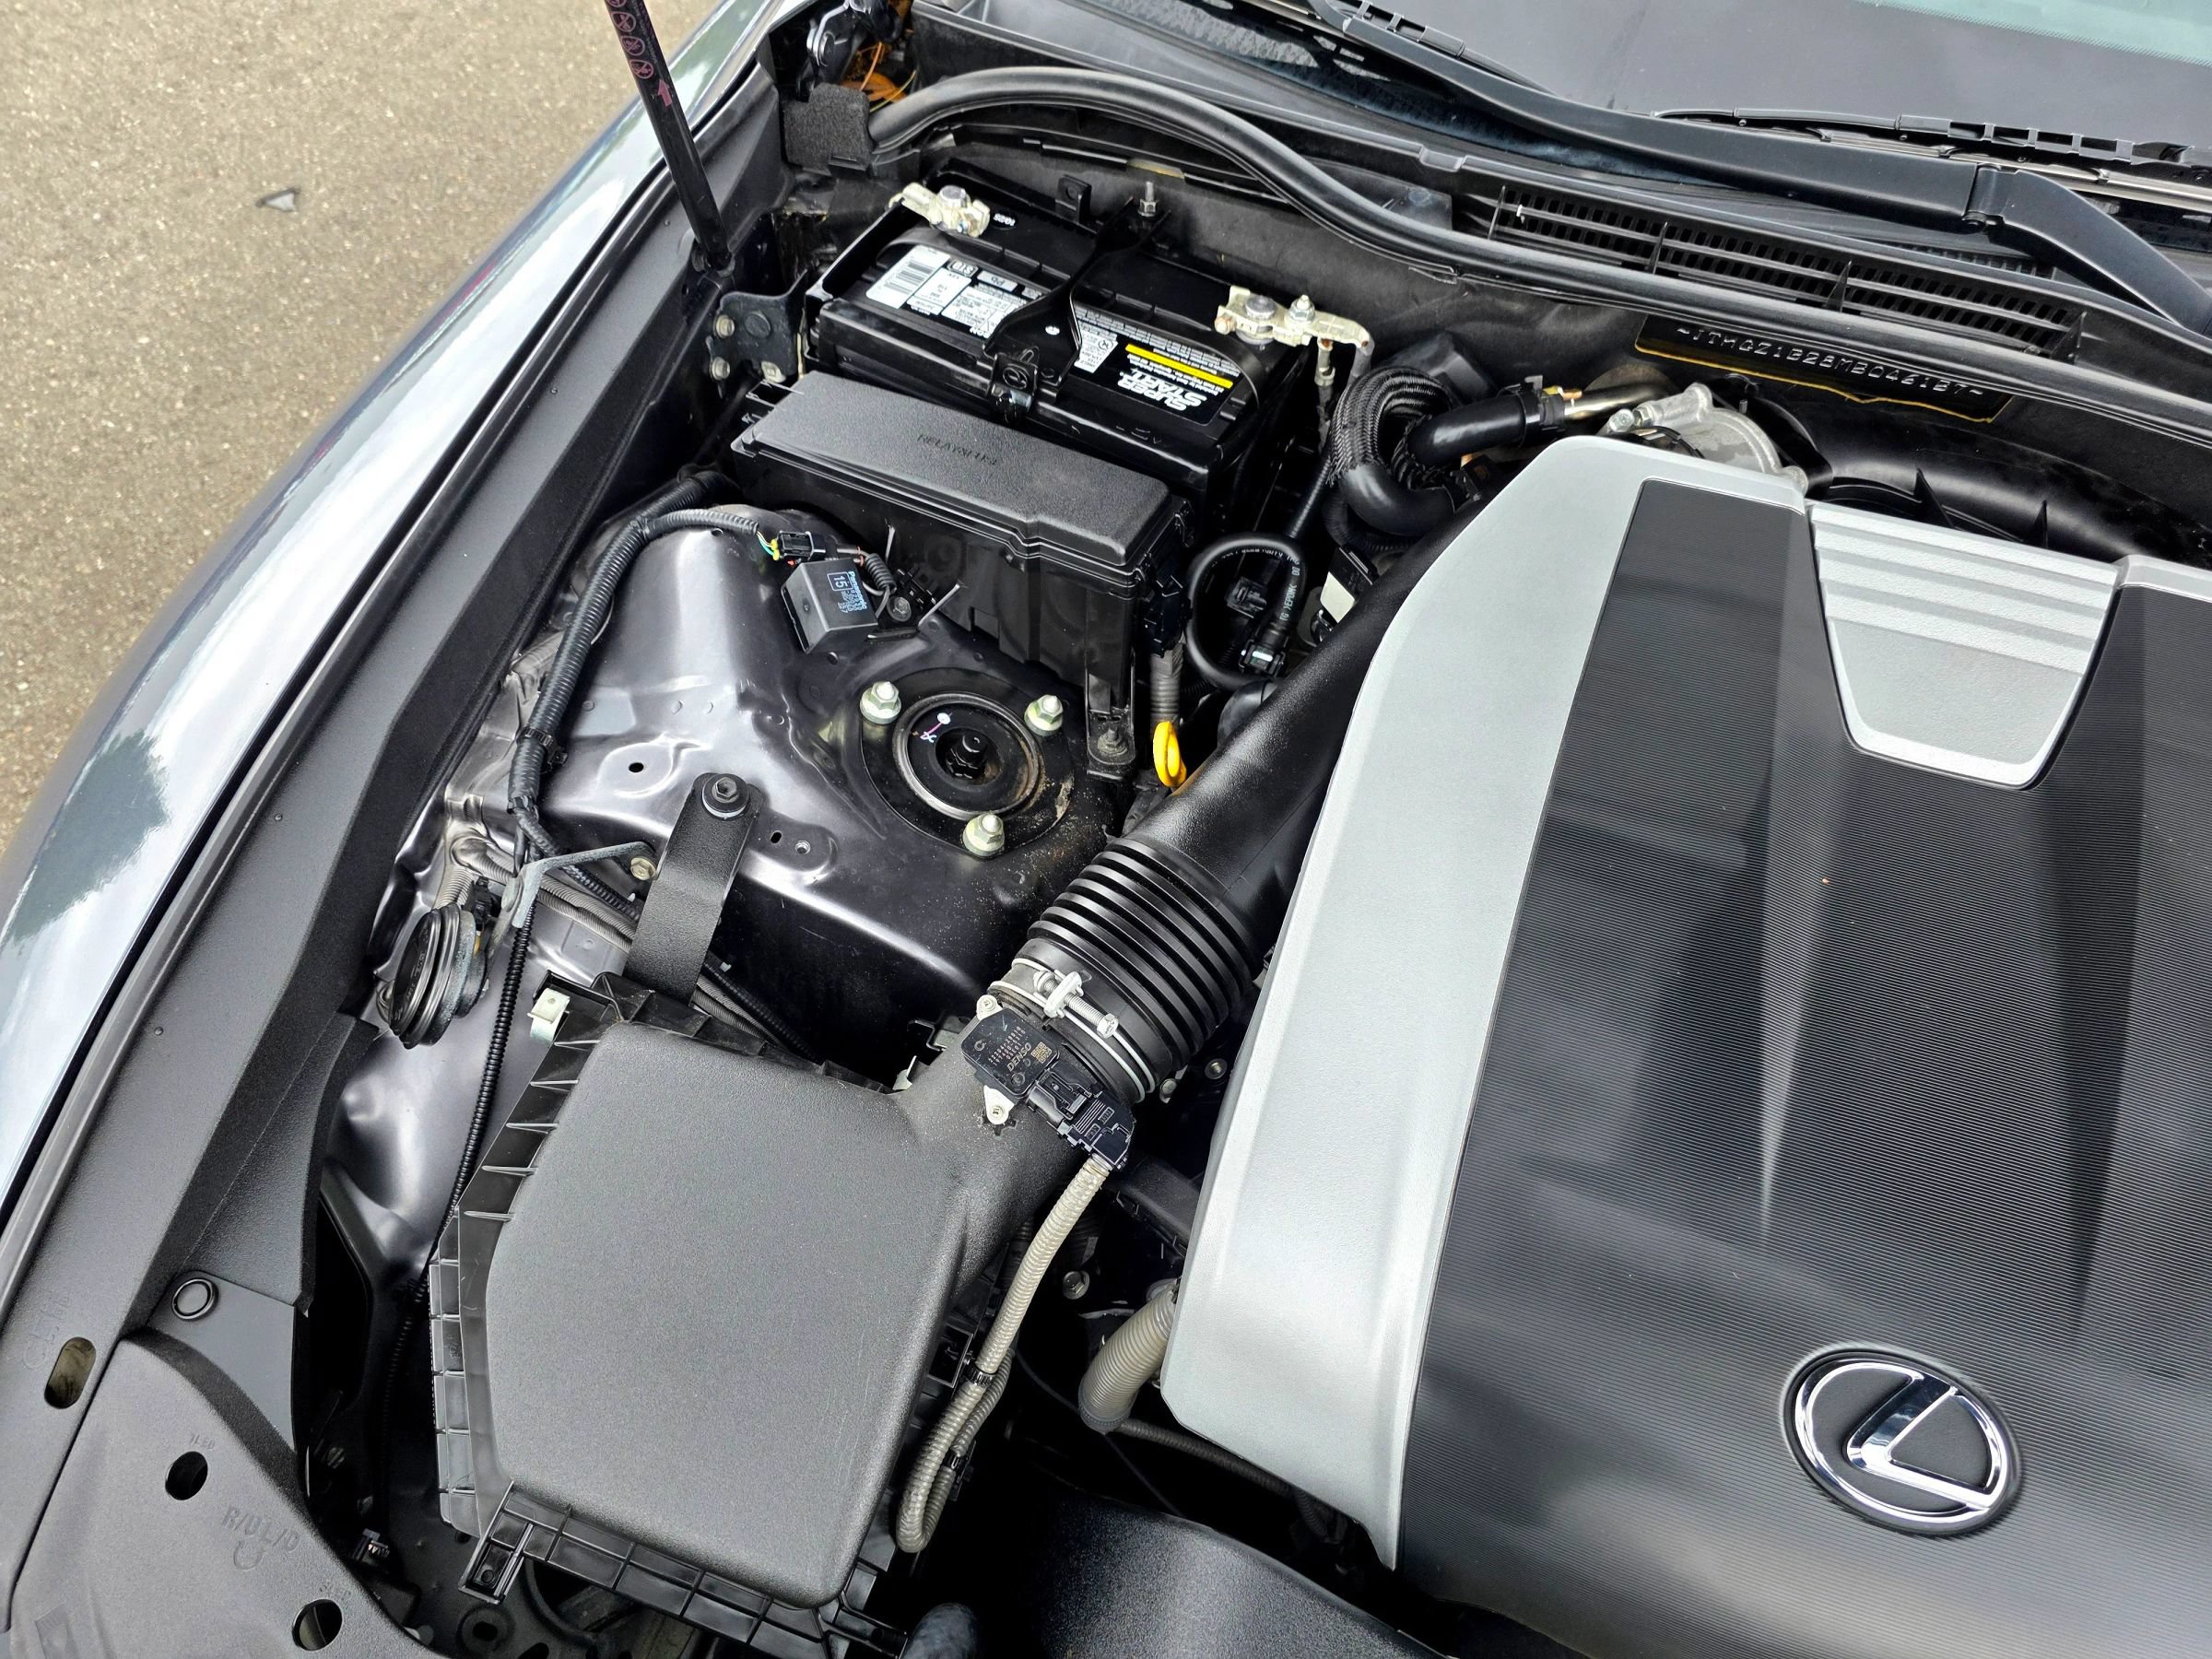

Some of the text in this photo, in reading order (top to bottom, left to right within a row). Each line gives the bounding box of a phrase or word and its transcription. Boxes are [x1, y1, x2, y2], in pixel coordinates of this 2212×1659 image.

[1119, 375, 1189, 412] SUPER
[1128, 367, 1207, 406] START
[833, 575, 848, 589] 15
[848, 571, 868, 611] Panasonic
[1006, 1042, 1032, 1072] DENSO
